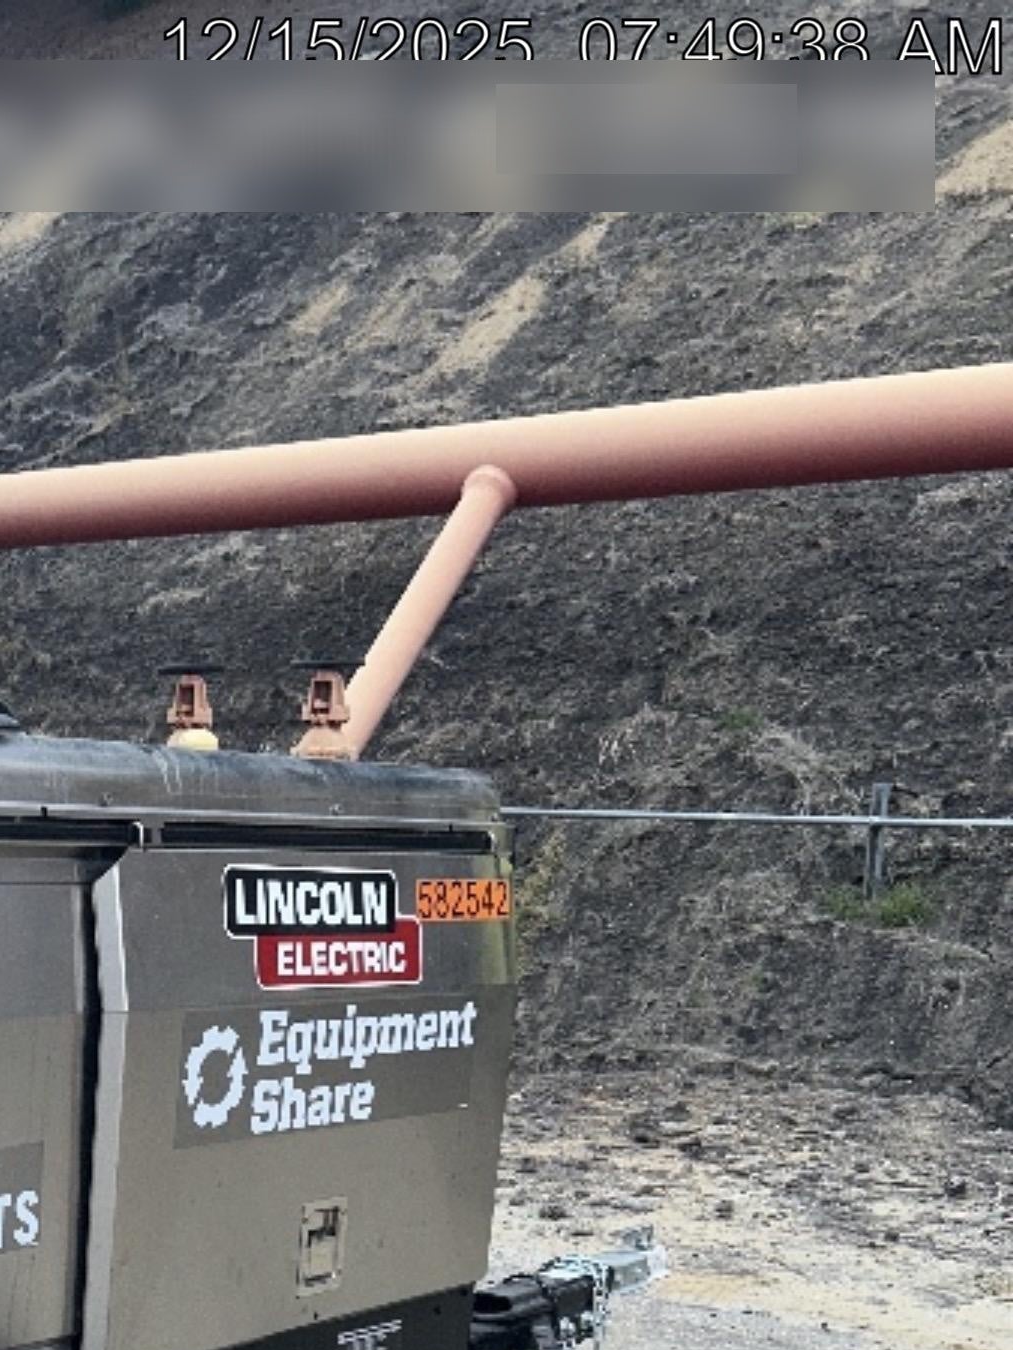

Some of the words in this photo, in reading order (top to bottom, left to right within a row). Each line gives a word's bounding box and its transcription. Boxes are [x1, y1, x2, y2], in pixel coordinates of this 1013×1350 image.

[235, 878, 388, 926] LINCOLN
[417, 880, 509, 920] 582542
[276, 941, 407, 977] ELECTRIC
[256, 1001, 478, 1075] Equipment
[250, 1076, 375, 1135] Share
